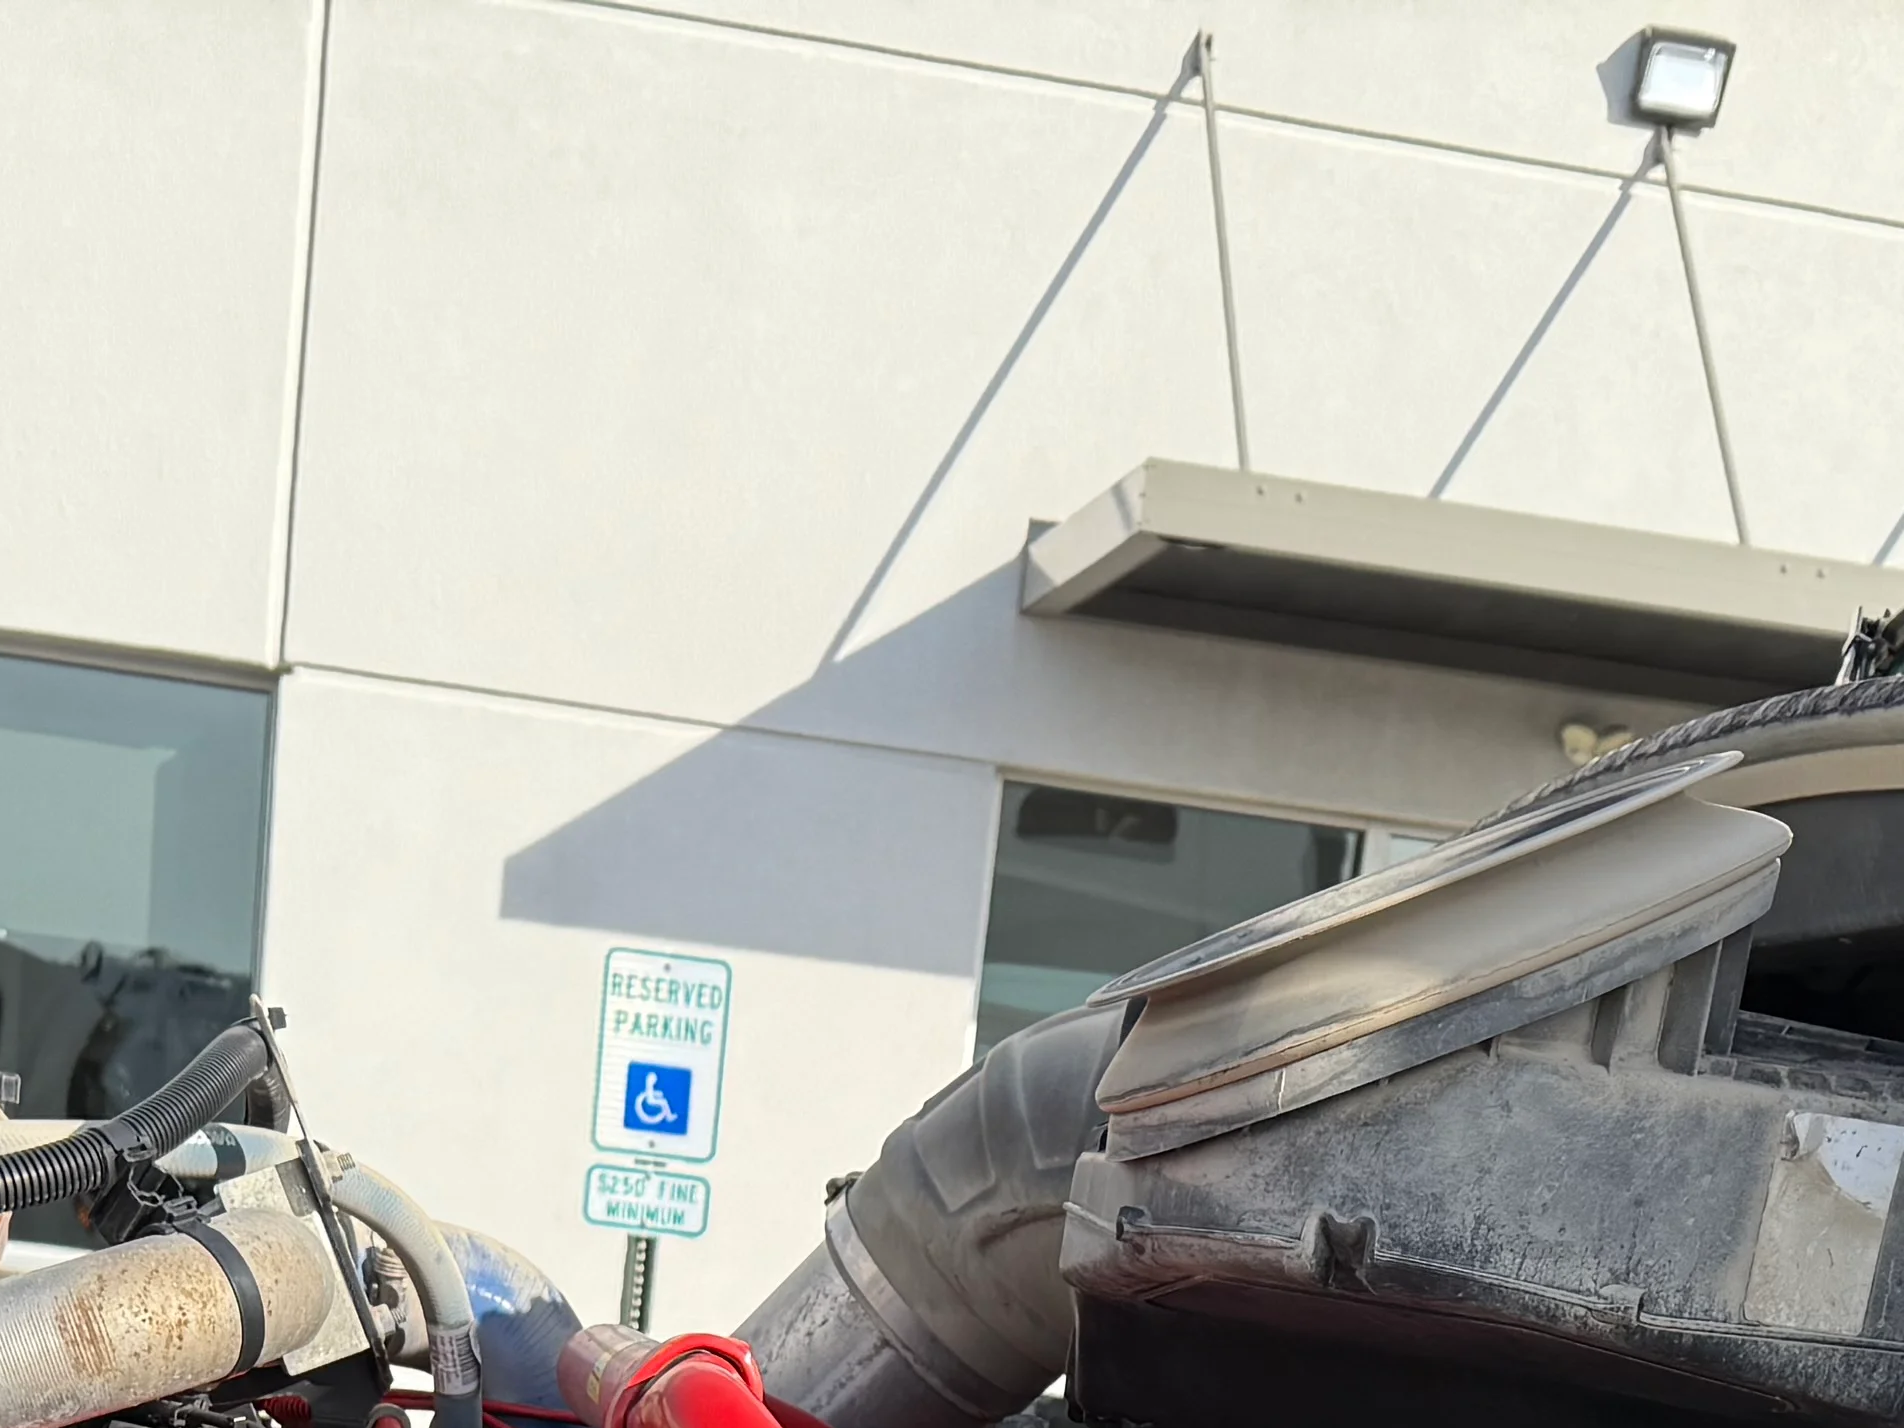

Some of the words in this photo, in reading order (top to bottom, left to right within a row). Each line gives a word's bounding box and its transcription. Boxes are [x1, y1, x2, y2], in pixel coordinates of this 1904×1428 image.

[610, 972, 724, 1010] RESERVED
[613, 1010, 713, 1045] PARKING
[597, 1173, 645, 1198] $250
[658, 1180, 698, 1204] FINE
[606, 1202, 686, 1227] MINIMUM
